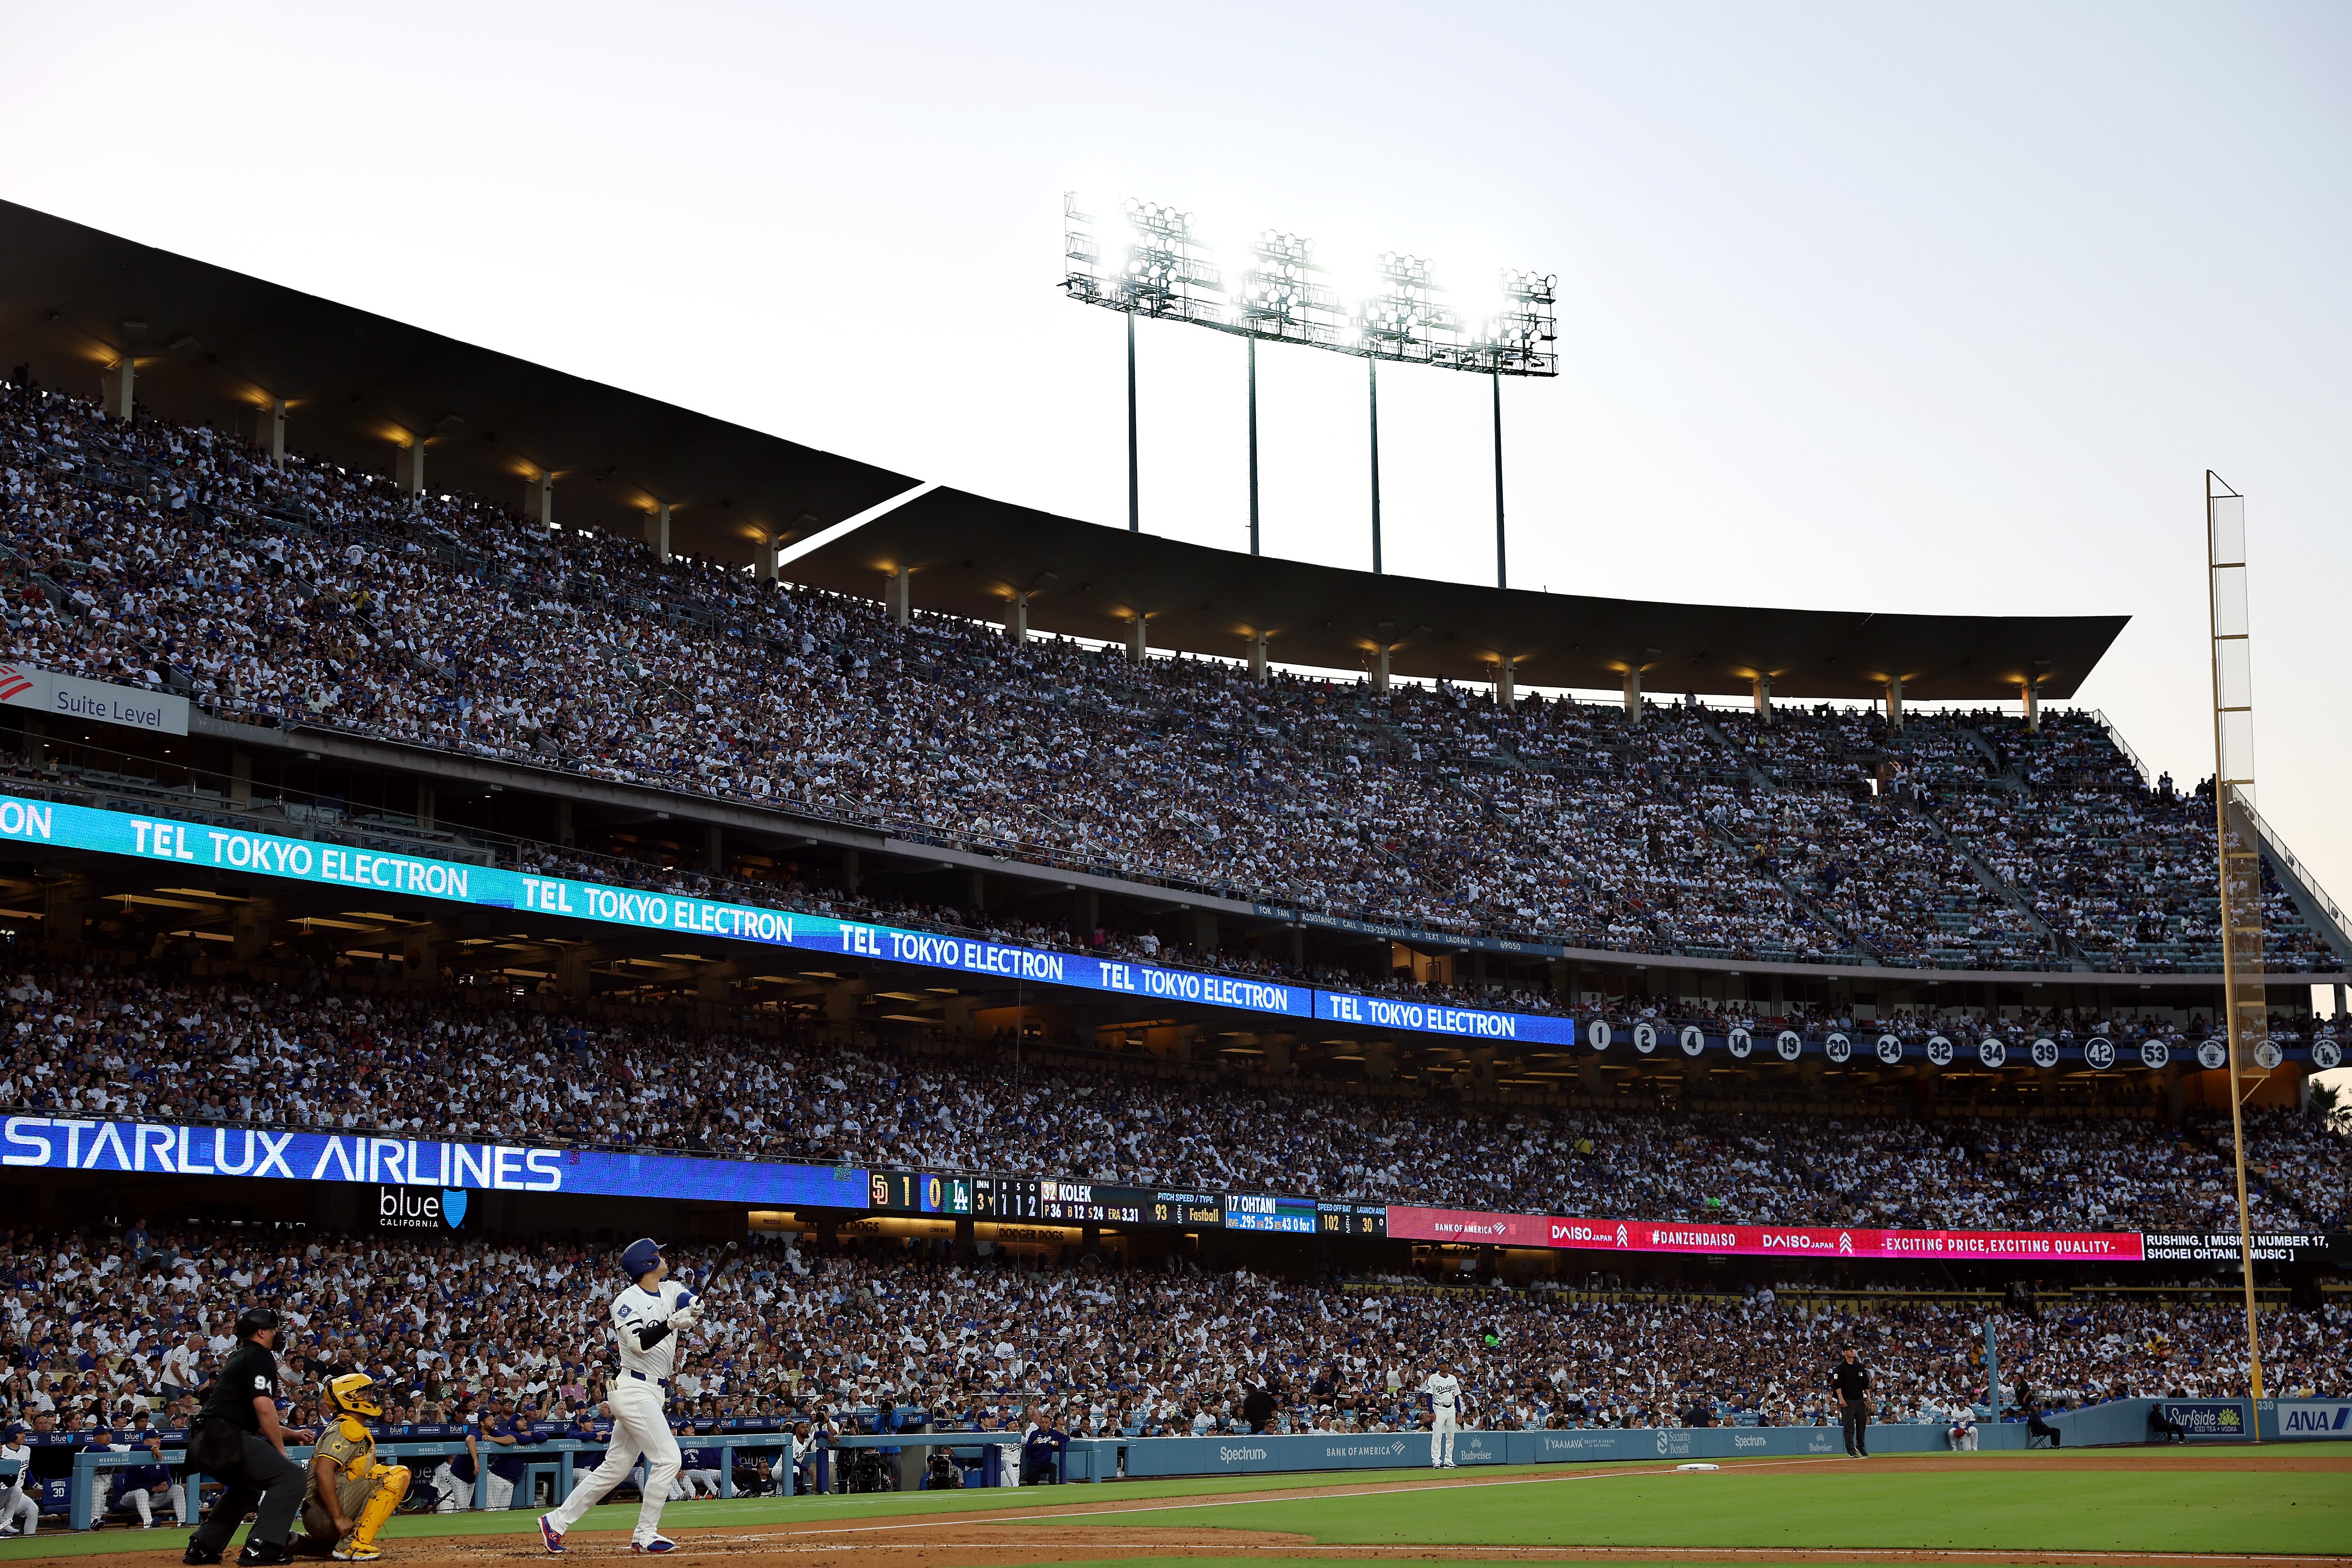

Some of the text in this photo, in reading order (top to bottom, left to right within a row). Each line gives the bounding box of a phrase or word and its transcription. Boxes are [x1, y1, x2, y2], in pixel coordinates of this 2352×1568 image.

[57, 691, 160, 727] Suite Level
[131, 819, 468, 896] TEL TOKYO ELECTRON
[522, 878, 792, 942] TEL TOKYO ELECTRON
[1259, 906, 1271, 915] FOR
[1277, 909, 1289, 918] FAN
[1302, 913, 1337, 925] ASSISTANCE
[1343, 920, 1357, 929] CALL
[1363, 924, 1405, 937] 323-224-2611
[1425, 933, 1439, 941] TEXT
[1446, 935, 1470, 945] LADFAN
[1500, 942, 1521, 950] 69050
[839, 924, 1063, 980] TEL TOKYO ELECTRON
[1099, 962, 1287, 1011] TEL TOKYO ELECTRON
[1330, 995, 1515, 1037] TEL TOKYO ELECTRON
[1597, 1027, 1602, 1044] 1
[1641, 1030, 1650, 1046] 2
[1687, 1032, 1697, 1049] 4
[1732, 1035, 1748, 1051] 14
[1782, 1037, 1797, 1053] 19
[1829, 1039, 1848, 1056] 20
[1880, 1041, 1900, 1057] 24
[1931, 1043, 1951, 1059] 32
[1984, 1045, 2003, 1061] 34
[2035, 1045, 2056, 1061] 39
[2145, 1045, 2166, 1061] 53
[2089, 1045, 2112, 1063] 42
[2321, 1048, 2334, 1064] LA
[2, 1117, 561, 1191] STARLUX AIRLINES
[903, 1177, 910, 1206] 1
[930, 1177, 941, 1207] 0
[977, 1180, 989, 1189] INN
[380, 1186, 438, 1217] blue
[953, 1180, 968, 1210] LA
[977, 1193, 984, 1210] 3
[1043, 1184, 1092, 1203] 32 KOLEK
[1158, 1192, 1174, 1201] PITCH
[1175, 1194, 1194, 1202] SPEED
[1199, 1195, 1214, 1204] TYPE
[1016, 1195, 1021, 1216] 1
[1028, 1196, 1036, 1216] 2
[1044, 1204, 1138, 1222] P 36 B 12 S 24 ERA 3.31
[1155, 1204, 1167, 1220] 93
[1228, 1196, 1276, 1214] 17 OHTANI
[1318, 1203, 1332, 1212] SPEED
[380, 1218, 438, 1227] CALIFORNIA
[1189, 1208, 1219, 1222] Fastball
[1324, 1215, 1339, 1231] 102
[850, 1221, 879, 1232] DOGS
[1240, 1216, 1255, 1229] .295
[1264, 1217, 1273, 1229] 25
[1282, 1218, 1291, 1230] 43
[1293, 1218, 1298, 1231] 0
[1300, 1218, 1310, 1231] for
[1311, 1219, 1315, 1231] 1
[1362, 1217, 1373, 1233] 30
[1435, 1223, 1453, 1232] BANK
[1464, 1225, 1492, 1234] AMERICA
[999, 1228, 1064, 1240] DODGER DOGS
[1552, 1225, 1591, 1241] DAISO
[1652, 1230, 1735, 1246] #DANZENDAISO
[1764, 1235, 1810, 1248] DAISO
[2147, 1235, 2201, 1245] RUSHING.
[2258, 1236, 2309, 1246] NUMBER
[2313, 1236, 2328, 1248] 17,
[2148, 1249, 2191, 1259] SHOHEI
[2194, 1249, 2240, 1259] OHTANI.
[2250, 1249, 2286, 1259] MUSIC
[2257, 1401, 2273, 1410] 330
[2169, 1408, 2216, 1428] Surfside
[2286, 1411, 2329, 1431] ANA
[1669, 1431, 1691, 1443] Security
[1735, 1435, 1764, 1449] Spectrum
[1220, 1446, 1263, 1464] Spectrum
[1327, 1447, 1390, 1457] BANK OF AMERICA
[1461, 1450, 1492, 1460] Budweiser
[1670, 1444, 1689, 1454] Benefit
[53, 1488, 64, 1497] 30
